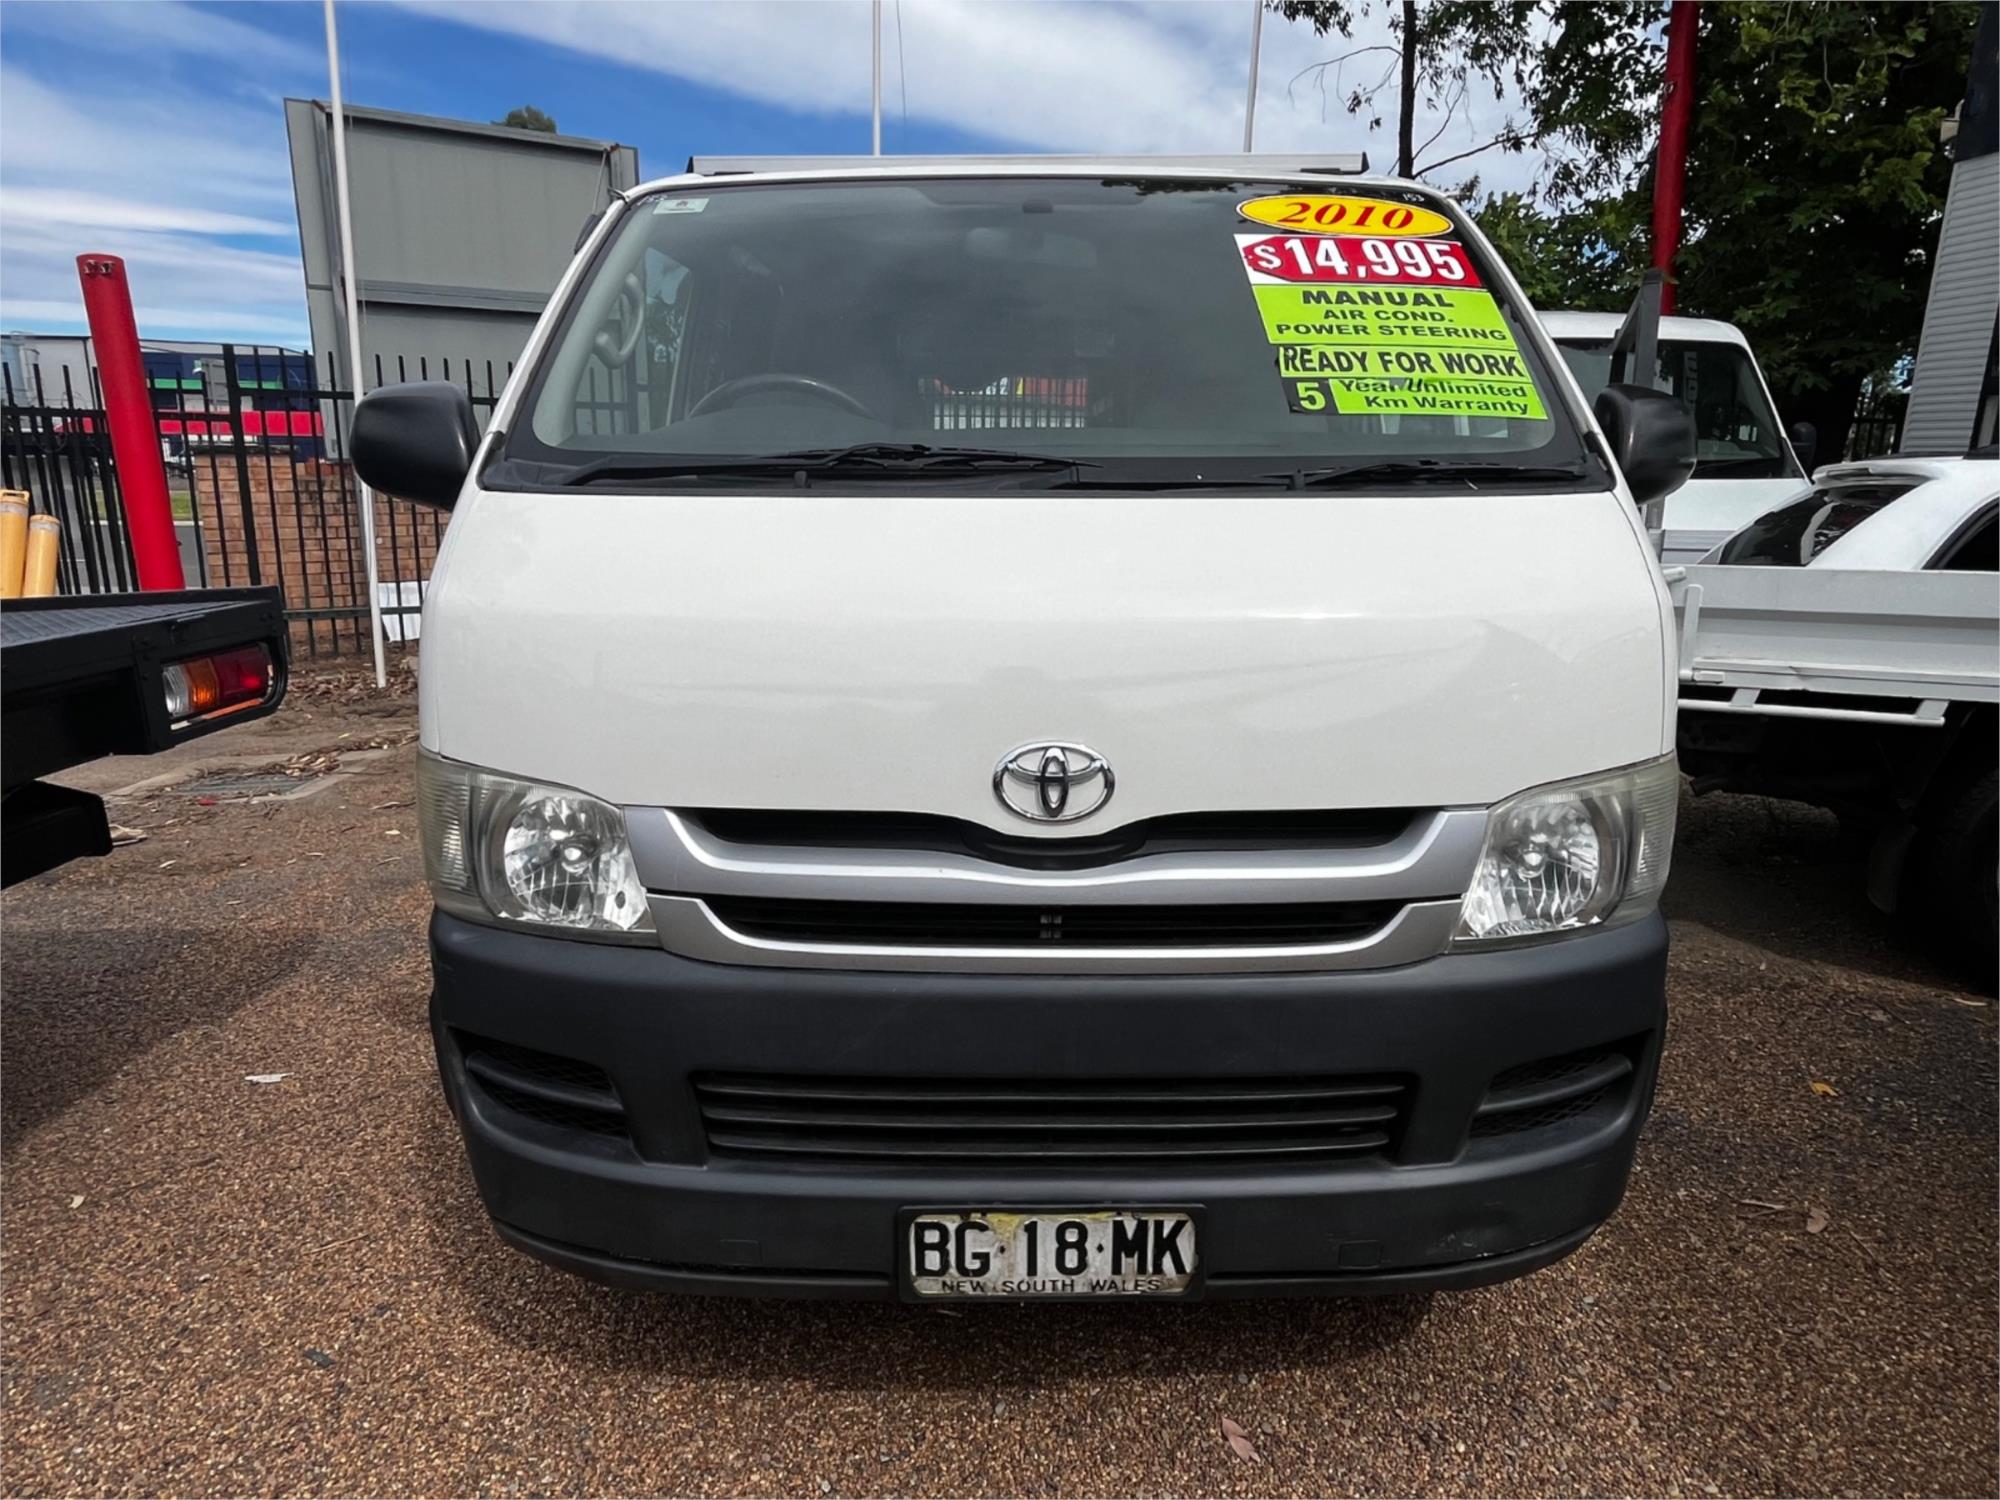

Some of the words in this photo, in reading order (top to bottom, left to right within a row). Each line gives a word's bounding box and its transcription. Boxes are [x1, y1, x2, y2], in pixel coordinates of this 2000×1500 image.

[1277, 202, 1414, 229] 2010
[1302, 290, 1455, 308] MANUAL
[1323, 309, 1367, 321] AIR
[1374, 310, 1454, 323] COND.
[1276, 323, 1371, 336] POWER
[1378, 325, 1507, 341] STEERING
[1283, 346, 1368, 372] READY
[1379, 351, 1437, 374] FOR
[1438, 353, 1525, 378] WORK
[1295, 382, 1326, 411] 5
[1364, 395, 1409, 409] Km
[1412, 396, 1529, 416] Warranty
[942, 1280, 987, 1293] NEW
[1004, 1279, 1075, 1293] SOUTH
[1091, 1279, 1161, 1292] WALES
